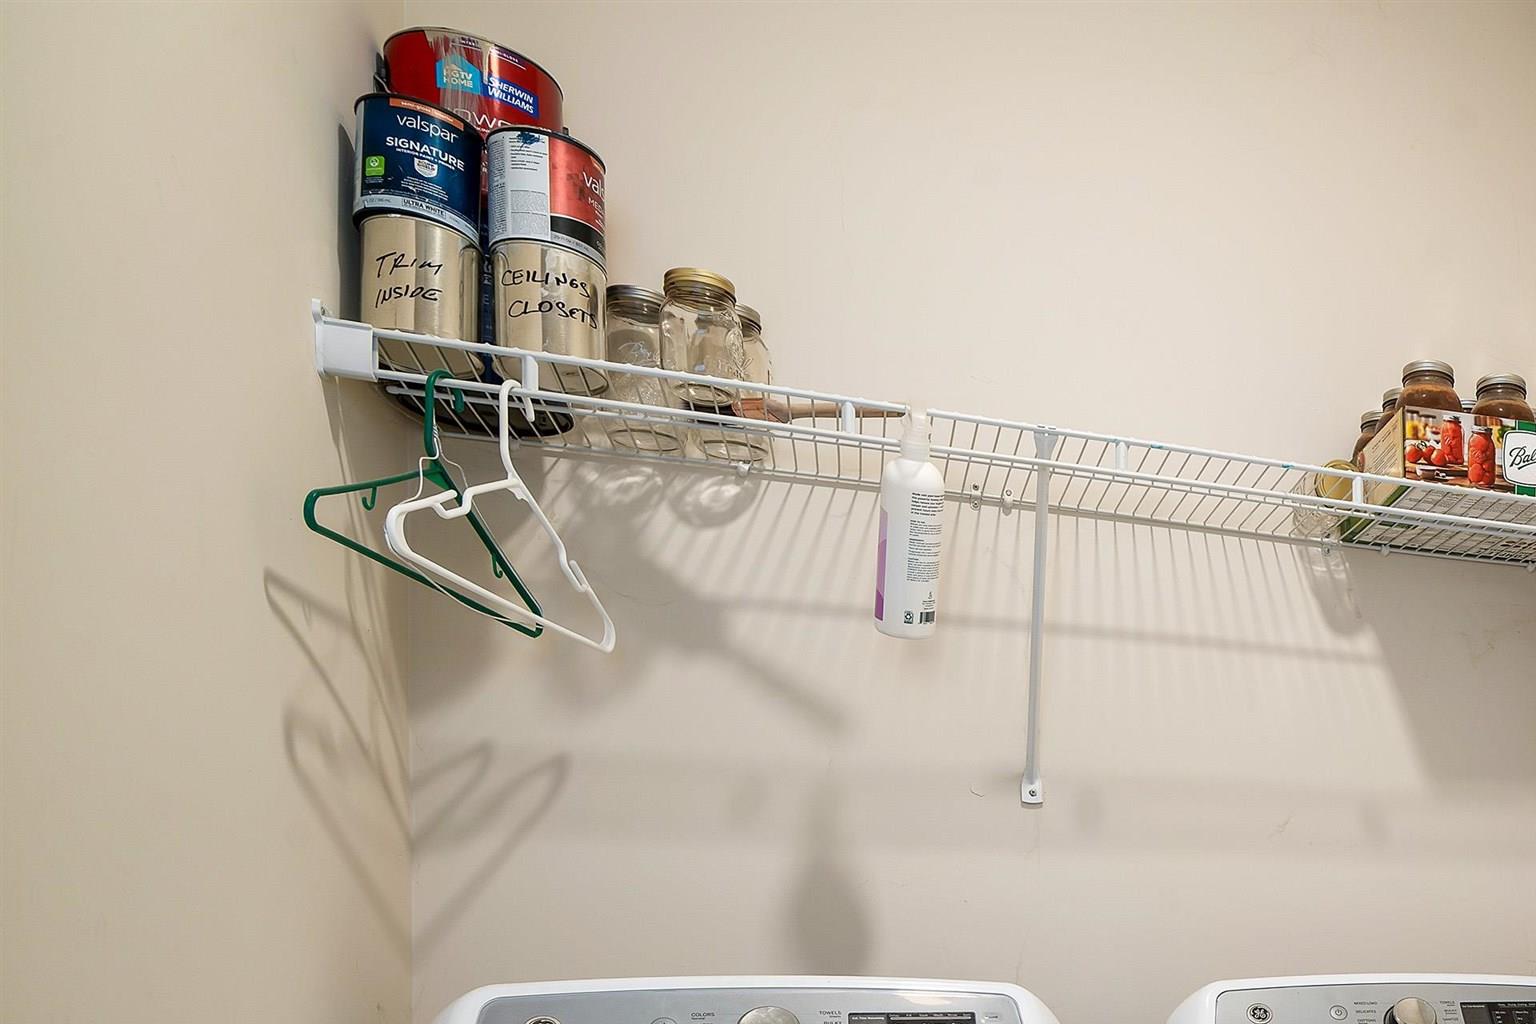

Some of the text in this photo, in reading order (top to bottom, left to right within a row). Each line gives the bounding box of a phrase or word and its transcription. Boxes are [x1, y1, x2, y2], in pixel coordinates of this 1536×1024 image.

[443, 77, 473, 88] HOME
[488, 77, 533, 104] SHERWIN
[487, 86, 534, 114] WILLIAMS
[396, 114, 459, 143] valspar
[386, 136, 465, 172] SIGNATURE
[582, 171, 605, 201] val
[403, 199, 423, 209] ULTRA
[425, 206, 445, 217] WHITE
[375, 284, 443, 308] INSIDE
[501, 269, 592, 299] CEILINGS
[508, 300, 598, 330] CLOSETS
